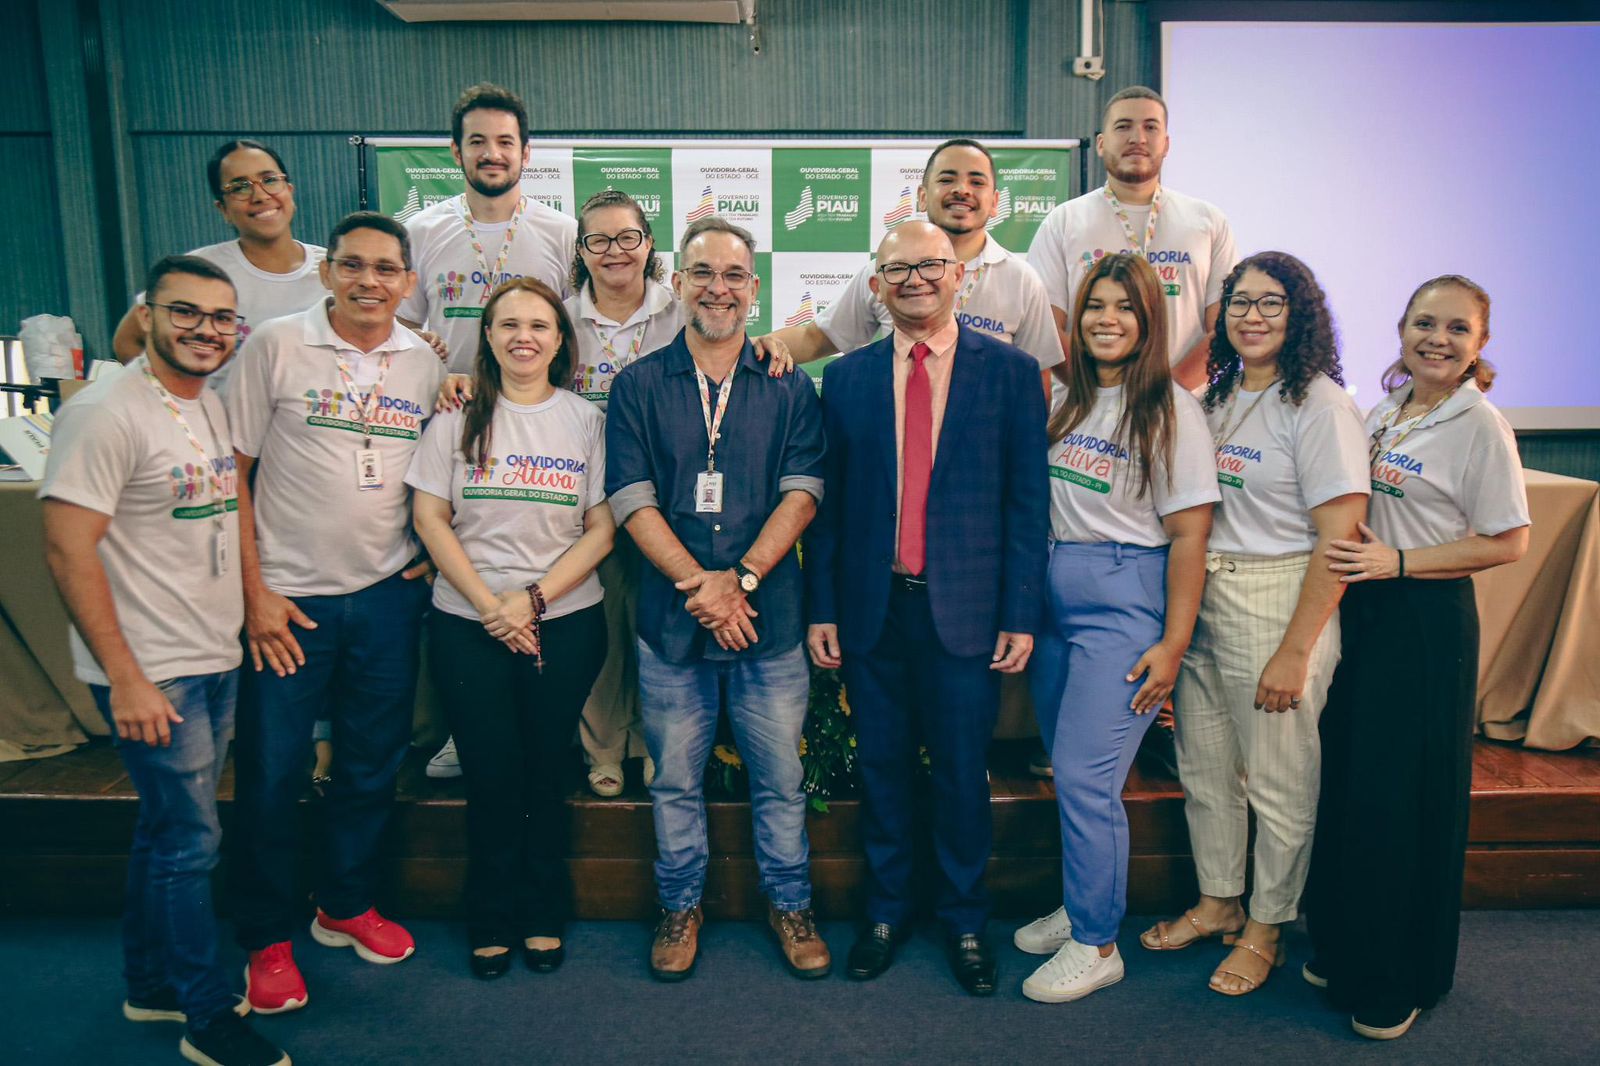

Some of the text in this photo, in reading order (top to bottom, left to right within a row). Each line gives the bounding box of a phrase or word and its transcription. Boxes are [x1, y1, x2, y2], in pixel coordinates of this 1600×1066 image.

[959, 313, 1005, 333] IDORIA
[1063, 433, 1128, 460] OUVIDORIA
[1223, 444, 1262, 463] IDORIA
[506, 454, 585, 474] OUVIDORIA
[1056, 446, 1111, 477] Ativa
[1381, 451, 1423, 475] DORIA
[502, 459, 576, 489] Ativa
[464, 488, 502, 496] OUVIDORIA
[503, 489, 527, 498] GERAL
[529, 490, 540, 498] DO
[541, 492, 569, 502] ESTADO
